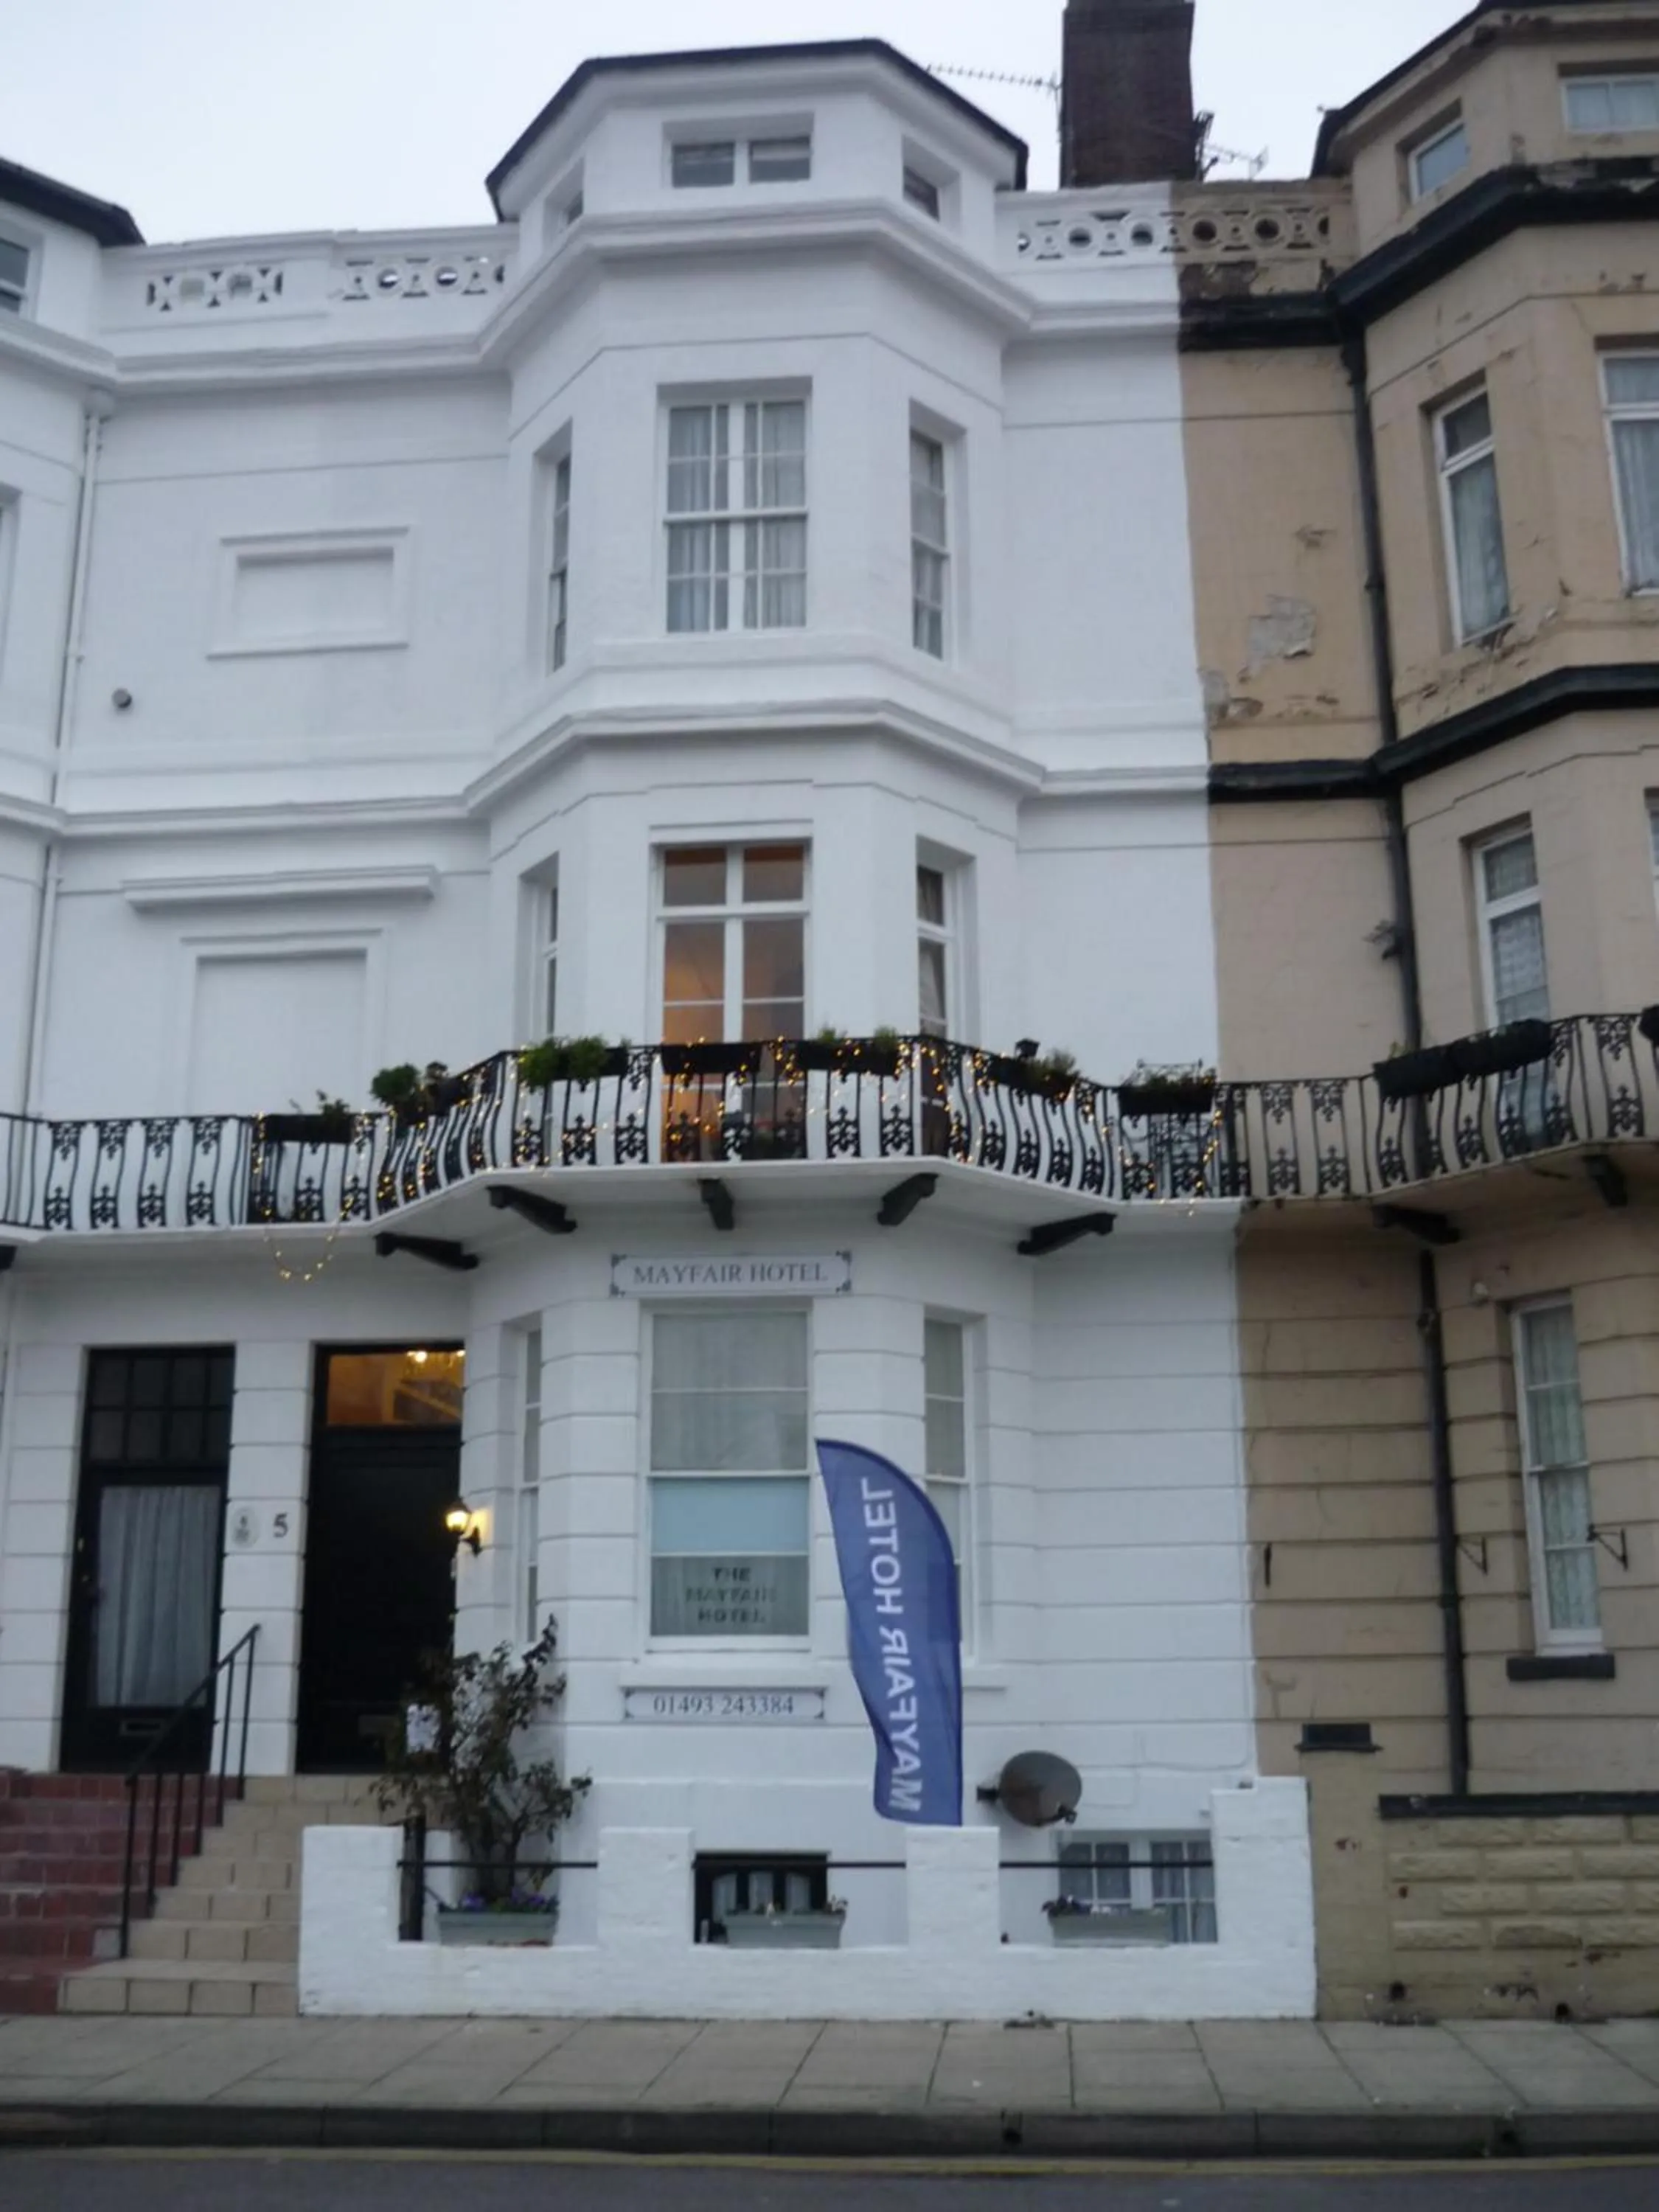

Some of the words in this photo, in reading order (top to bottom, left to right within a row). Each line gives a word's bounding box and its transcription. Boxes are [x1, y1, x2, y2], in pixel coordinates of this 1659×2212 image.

[633, 1264, 742, 1284] MAYFAIR
[749, 1262, 827, 1282] HOTEL
[273, 1512, 288, 1538] 5
[712, 1567, 751, 1582] THE
[653, 1695, 714, 1714] 01493
[720, 1695, 794, 1714] 243384
